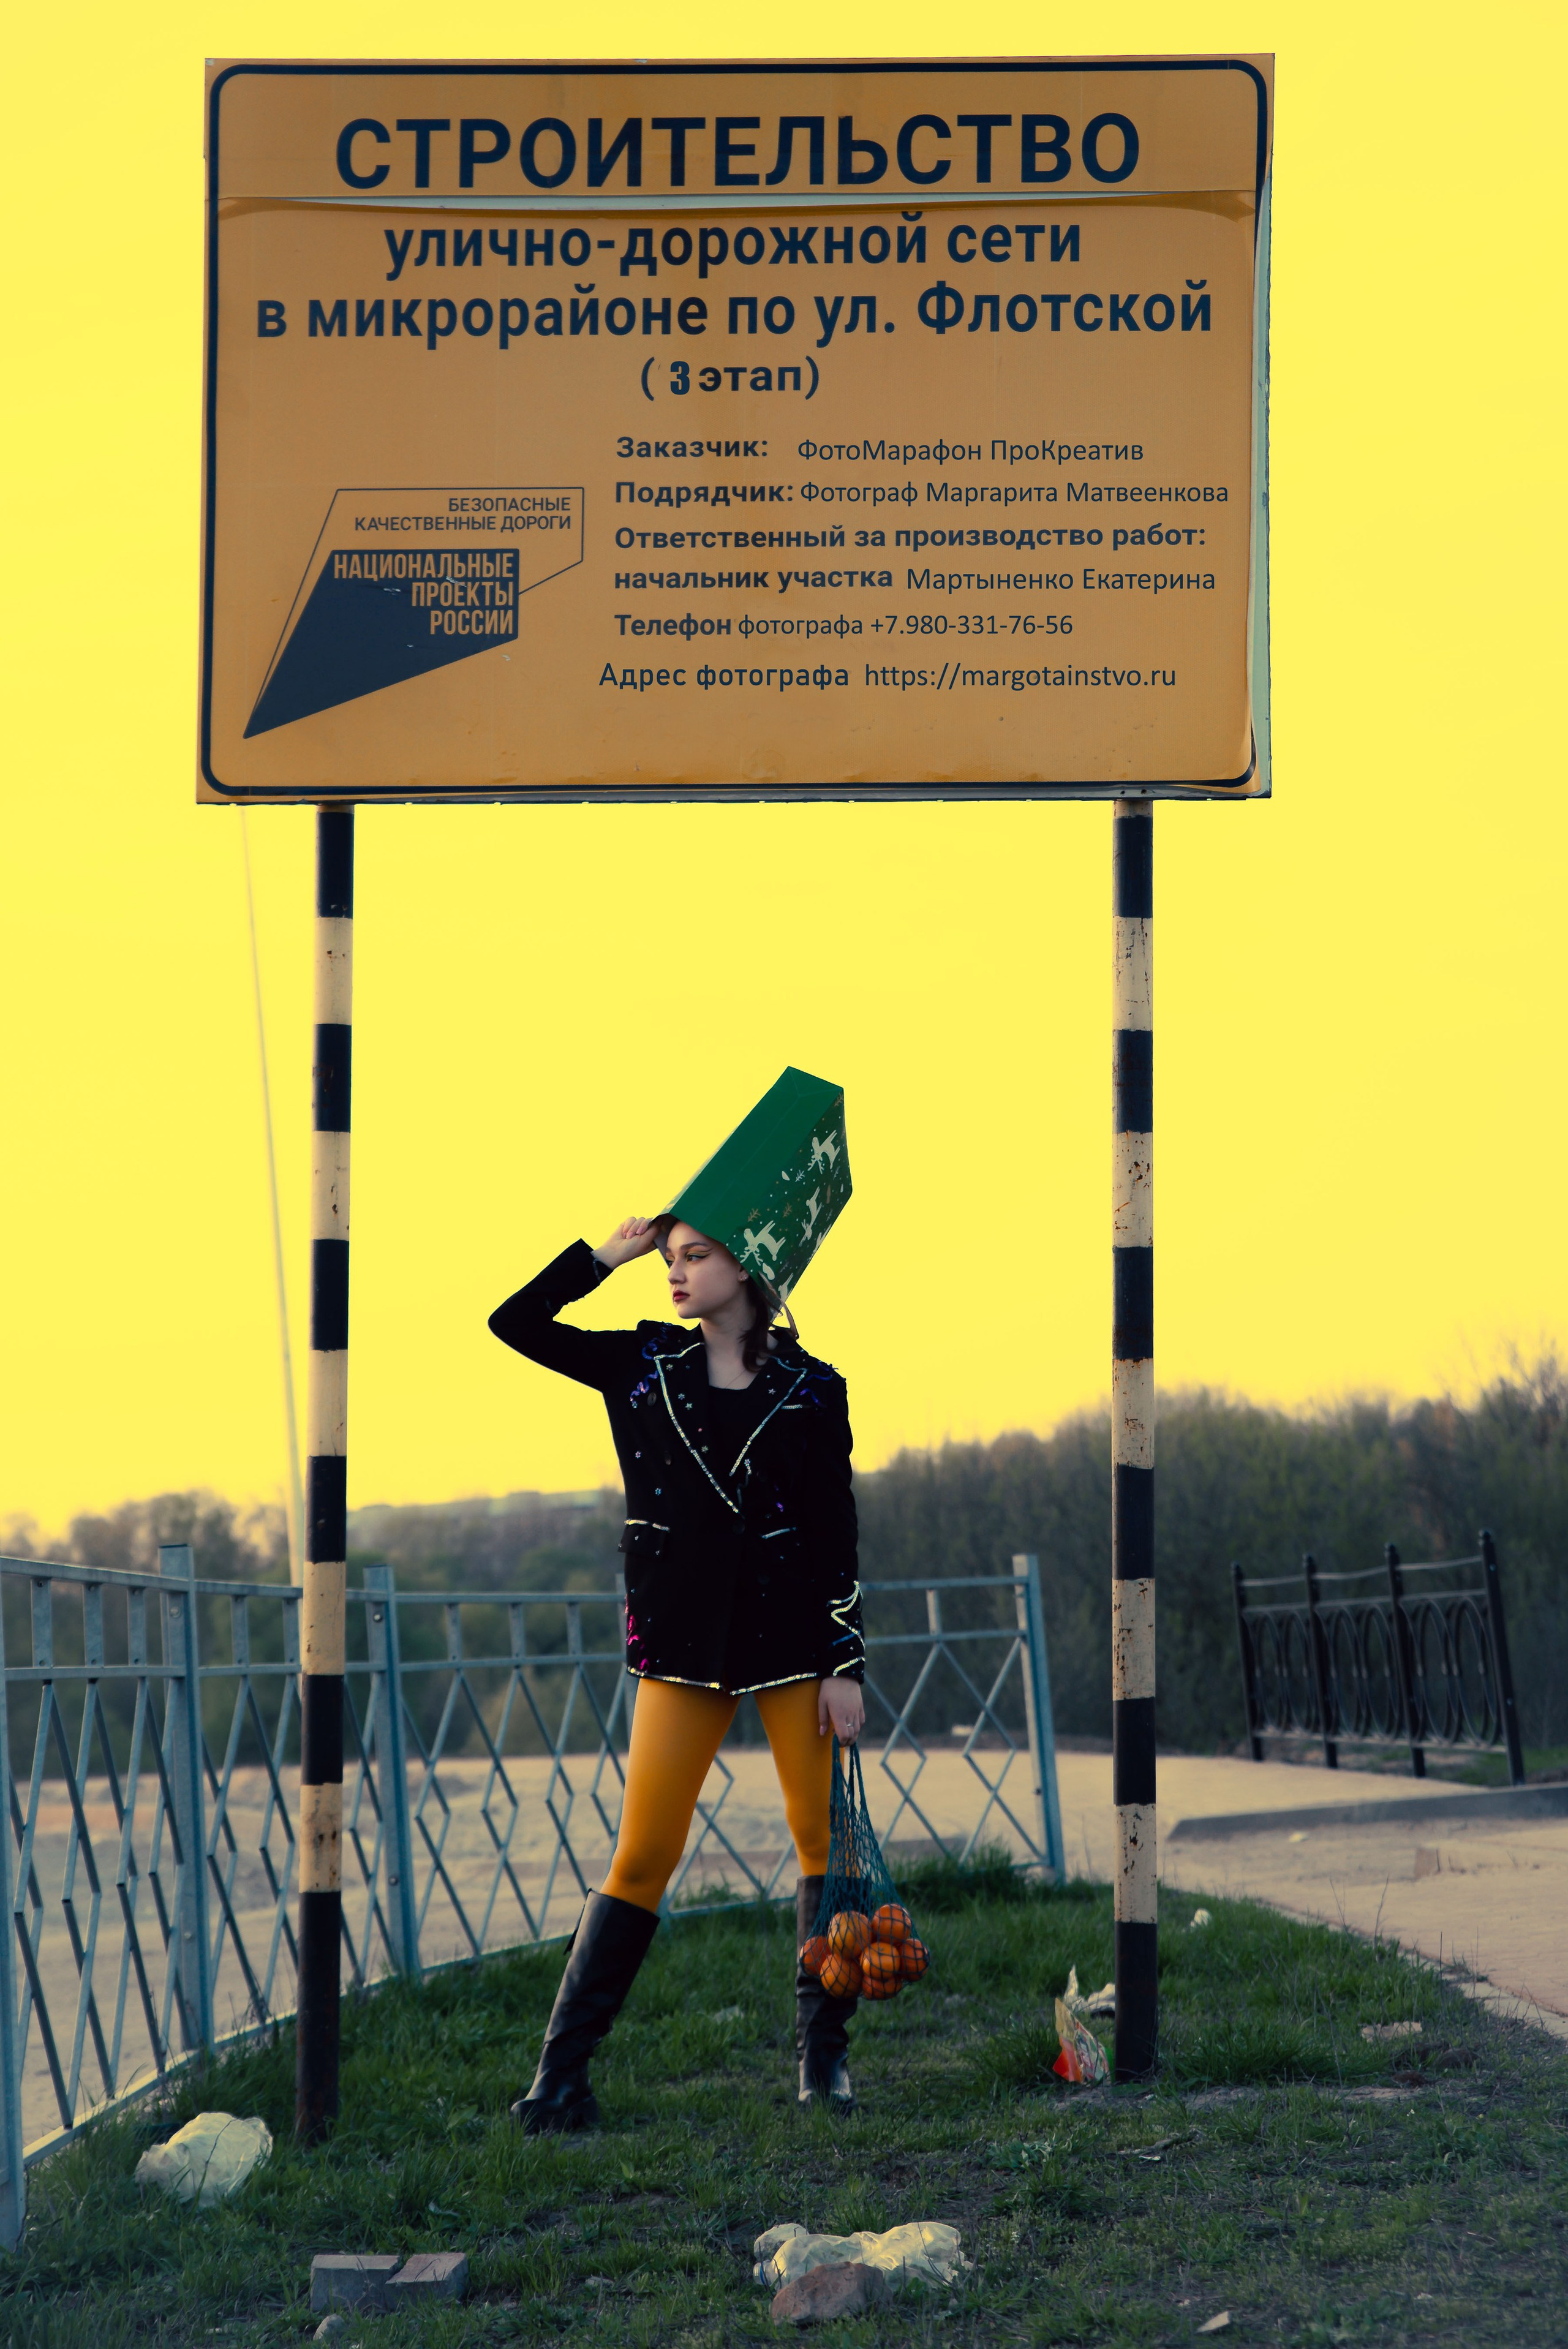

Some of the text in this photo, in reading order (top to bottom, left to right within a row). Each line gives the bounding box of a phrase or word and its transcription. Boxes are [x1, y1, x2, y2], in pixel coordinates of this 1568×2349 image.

[336, 113, 1139, 189] СТРОИТЕЛЬСТВО
[384, 211, 1079, 281] улично-дорожной сети
[258, 279, 1210, 350] в микрорайоне по ул. Флотской
[699, 356, 819, 399] этап)
[617, 437, 1143, 465] Заказчик: ФотоМарафон ПроКреатив
[450, 497, 570, 511] БЕЗОПАСНЫЕ
[616, 481, 1227, 508] Подрядчик: Фотограф Маргарита Матвеенкова
[356, 516, 570, 532] КАЧЕСТВЕННЫЕ ДОРОГИ
[616, 523, 1204, 551] Ответственный за производство работ:
[334, 552, 513, 581] НАЦИОНАЛЬНЫЕ
[412, 582, 513, 606] ПРОЕКТЫ
[616, 569, 1214, 594] начальник участка Мартыненко Екатерина
[431, 610, 513, 635] РОССИИ
[614, 613, 1072, 641] Телефон фотографа +7.980-331-76-56
[600, 663, 1175, 692] Адрес фотографа https://margotainstvo.ru
